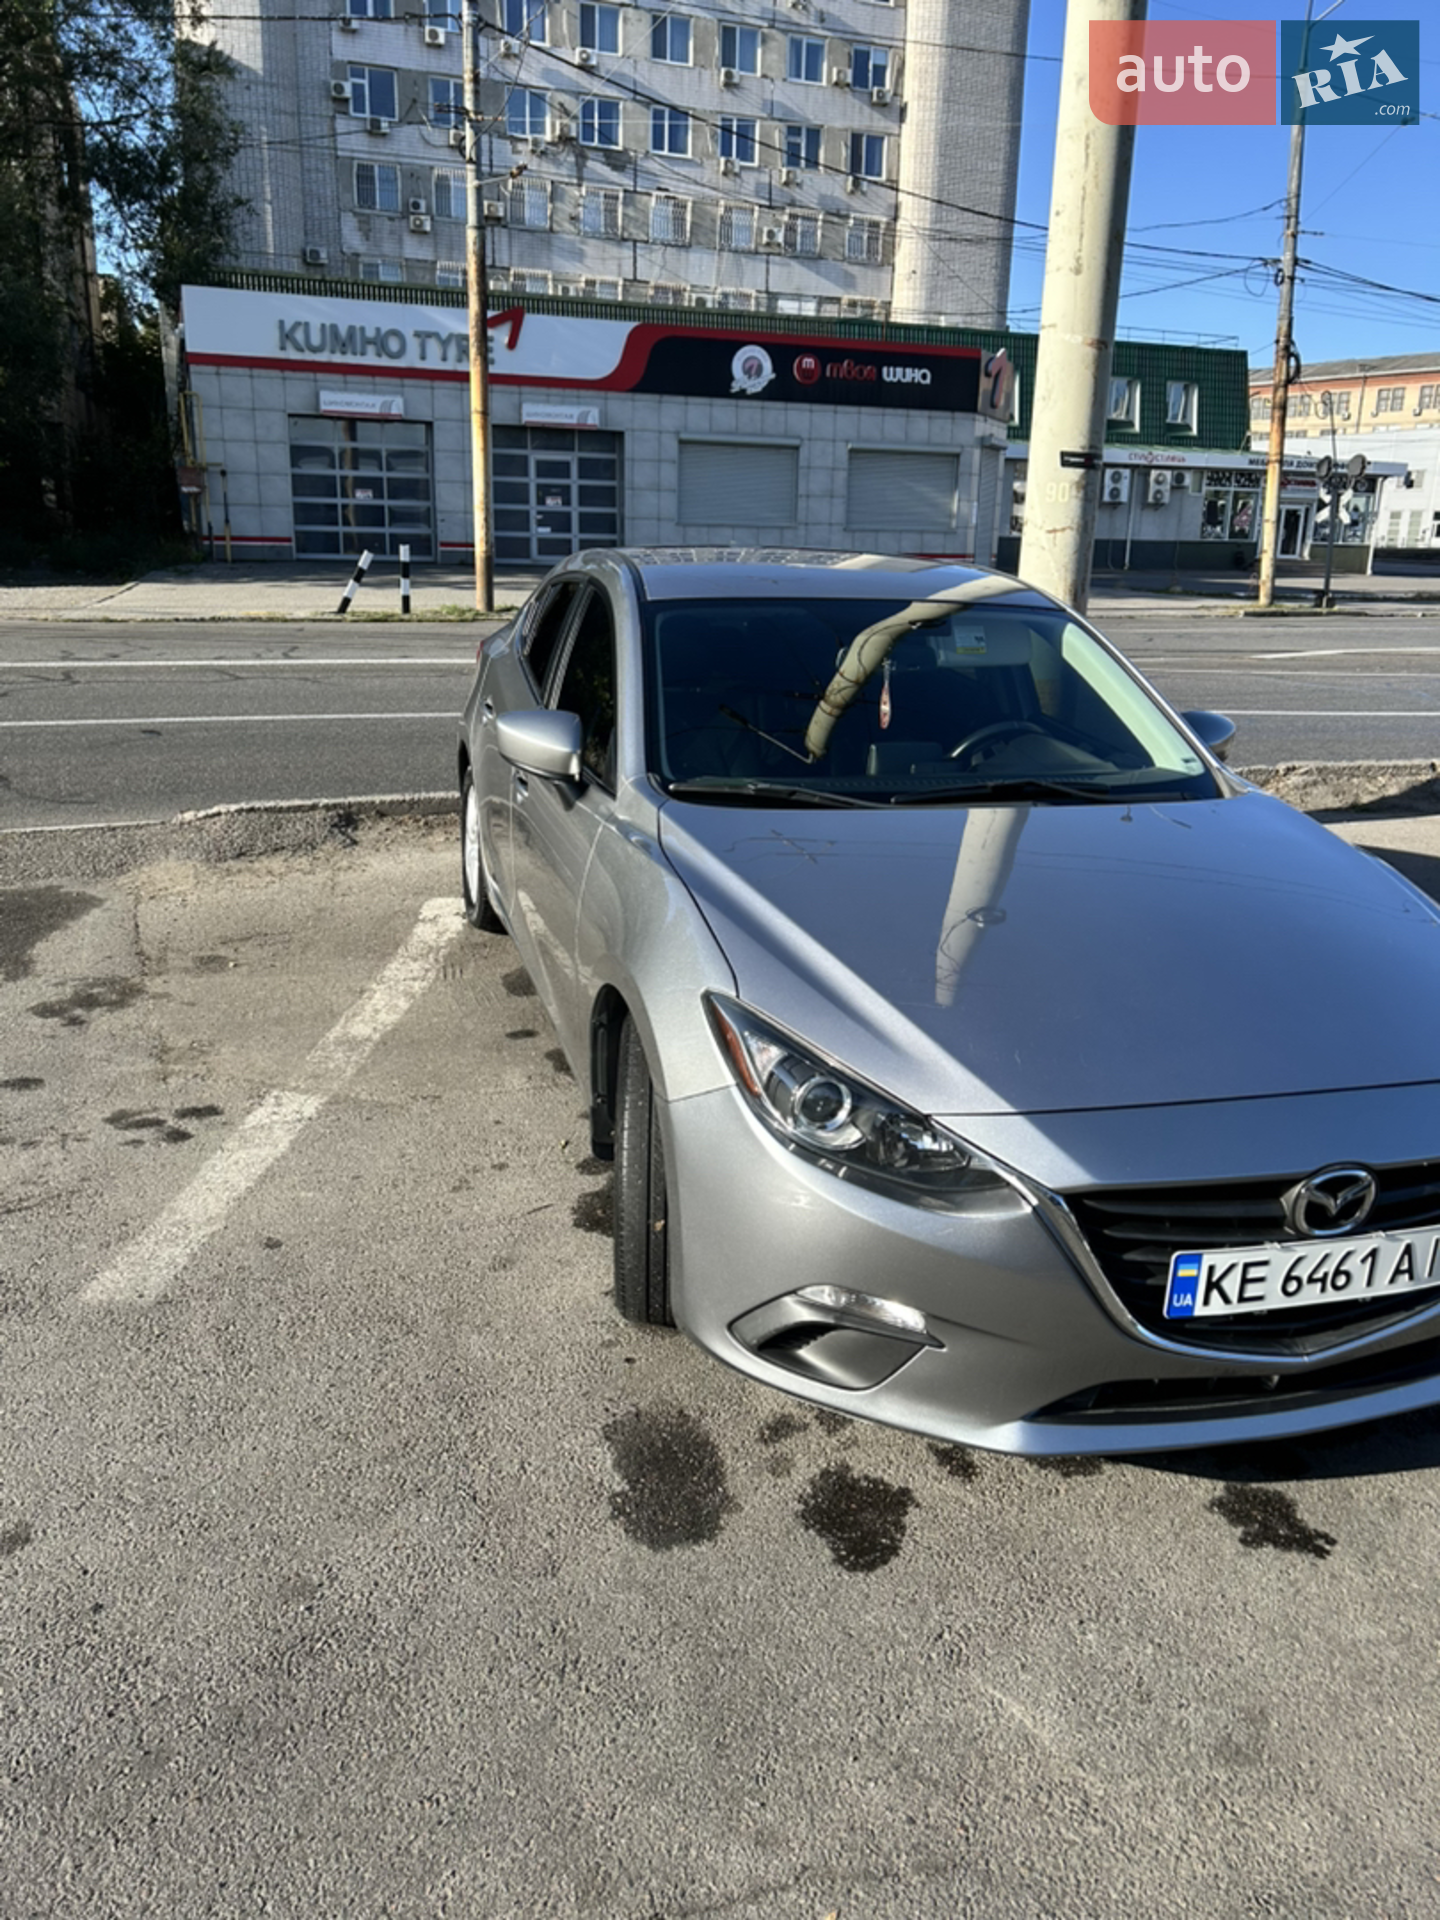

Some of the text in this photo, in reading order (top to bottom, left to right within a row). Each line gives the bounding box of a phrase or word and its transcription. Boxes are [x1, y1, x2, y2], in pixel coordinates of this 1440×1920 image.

[278, 319, 407, 360] KUMHO
[1202, 1260, 1271, 1307] KE
[1281, 1246, 1380, 1298] 6461
[1173, 1293, 1194, 1307] UA
